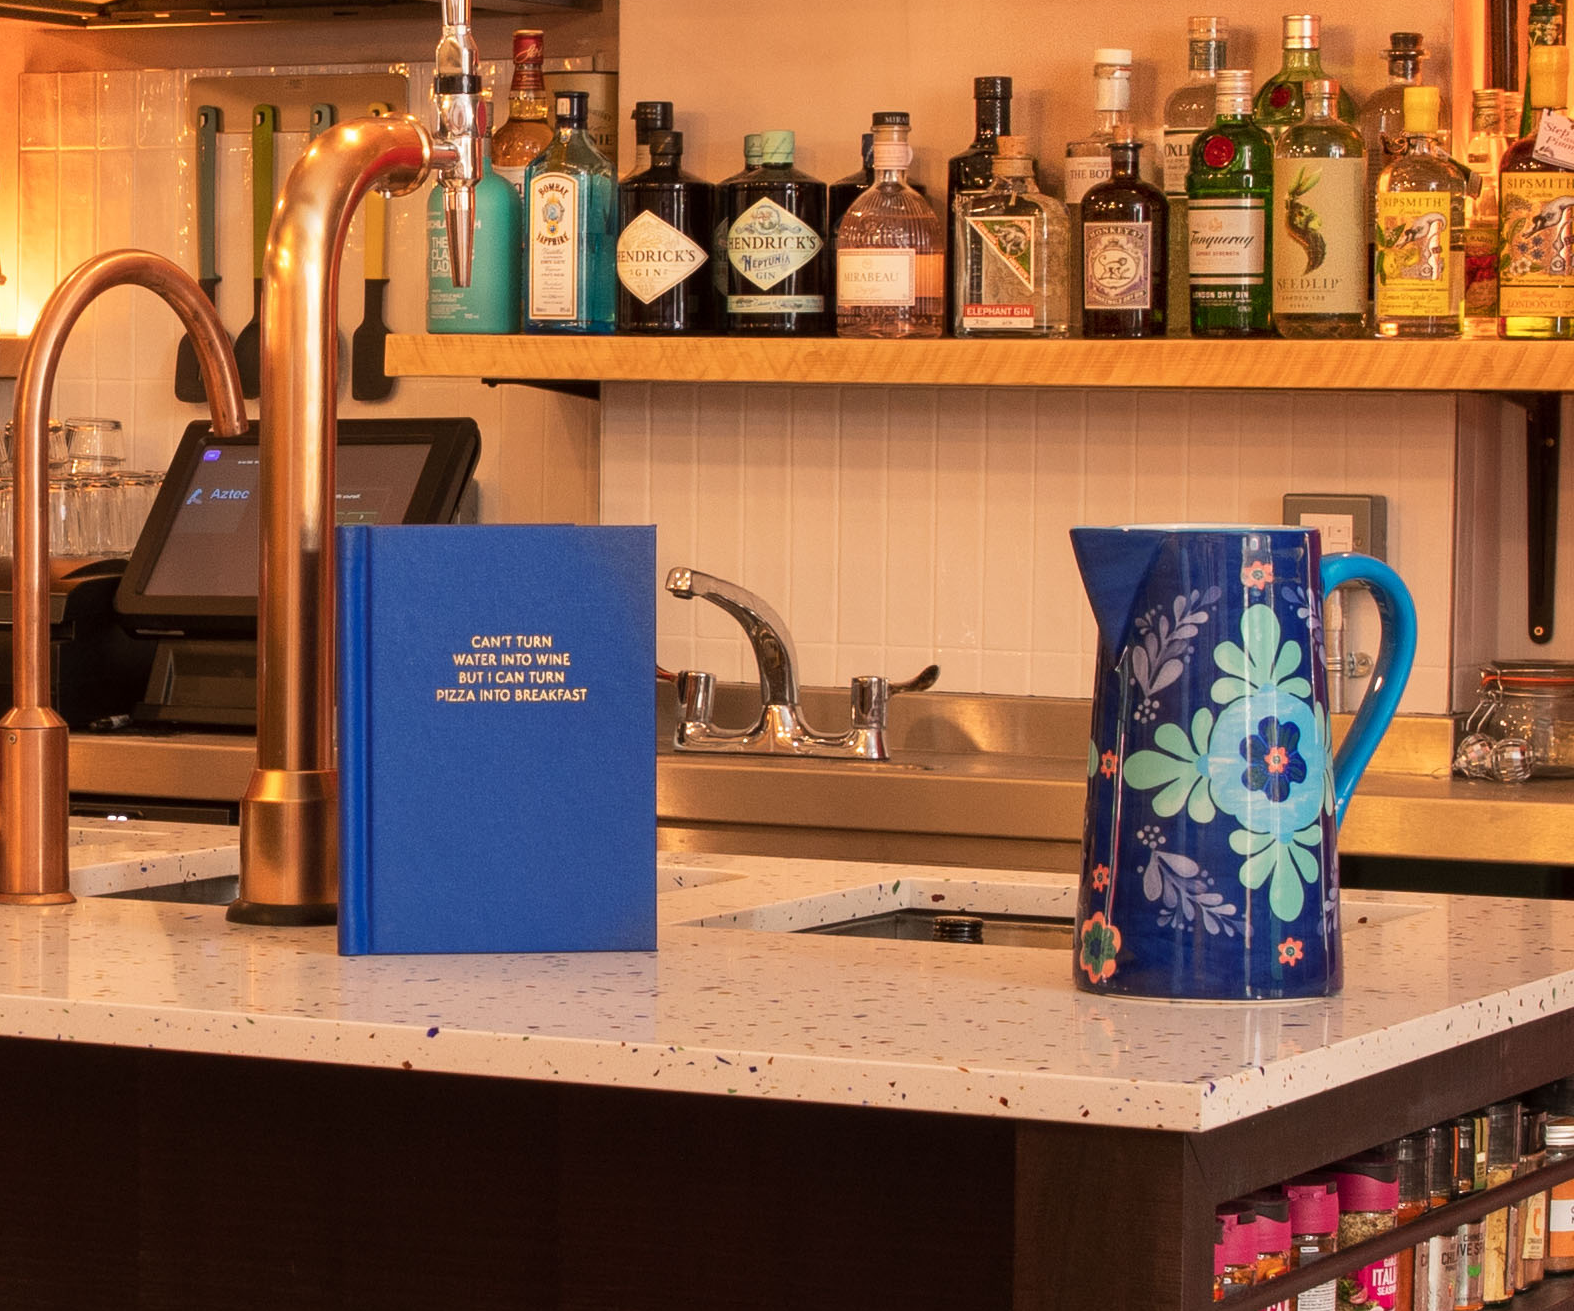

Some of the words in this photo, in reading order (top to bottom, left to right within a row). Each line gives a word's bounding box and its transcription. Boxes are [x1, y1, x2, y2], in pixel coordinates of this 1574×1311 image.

[1545, 121, 1569, 139] Step
[1070, 169, 1087, 179] THE
[1089, 169, 1111, 179] BOT
[1507, 178, 1574, 189] SIPSMITH
[537, 181, 569, 199] BOMBAY
[1383, 197, 1442, 208] SIPSMITH
[535, 232, 571, 246] SAPPHIRE
[1190, 230, 1255, 249] Tanqueray
[635, 269, 662, 277] GIN
[755, 271, 776, 280] GIN
[843, 272, 899, 282] MIRABEAU
[1277, 278, 1339, 289] SEEDLIP
[1217, 291, 1234, 299] DRY
[1507, 299, 1552, 309] LONDON
[1553, 299, 1572, 309] CUP
[966, 307, 1012, 316] ELEPHANT
[1013, 307, 1030, 316] GIN
[210, 487, 250, 501] Aztec
[472, 635, 512, 648] CAN'T
[516, 635, 552, 648] TURN
[453, 653, 497, 666] WATER
[501, 653, 532, 666] INTO
[536, 653, 571, 666] WINE
[458, 671, 484, 684] BUT
[488, 672, 492, 683] I
[495, 671, 525, 684] CAN
[529, 671, 565, 684] TURN
[436, 689, 475, 702] PIZZA
[480, 689, 511, 701] INTO
[515, 689, 587, 701] BREAKFAST
